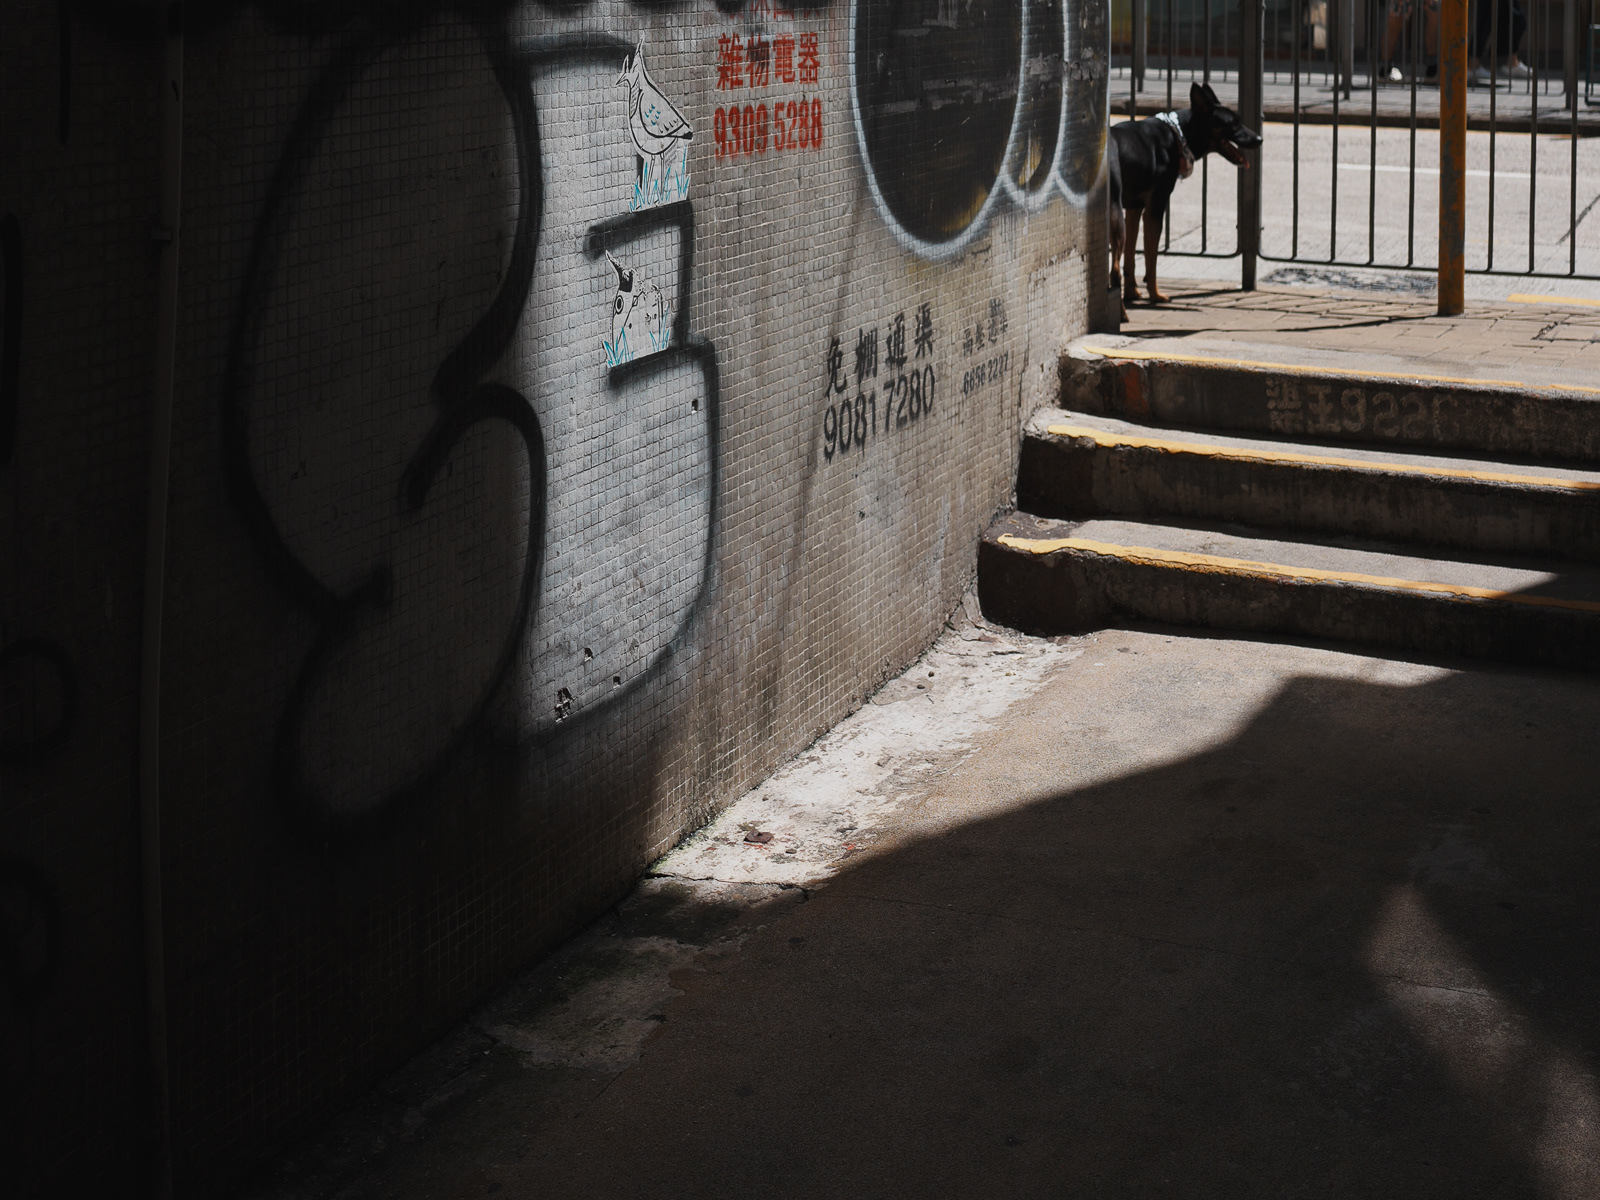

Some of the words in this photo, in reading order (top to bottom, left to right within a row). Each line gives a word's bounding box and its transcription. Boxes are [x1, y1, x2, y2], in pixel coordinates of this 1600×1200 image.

[716, 32, 820, 91] 雜物電器
[713, 103, 768, 158] 9309
[774, 98, 823, 152] 5288
[826, 302, 935, 398] 免棚通渠
[824, 392, 876, 460] 9081
[883, 364, 935, 431] 7280
